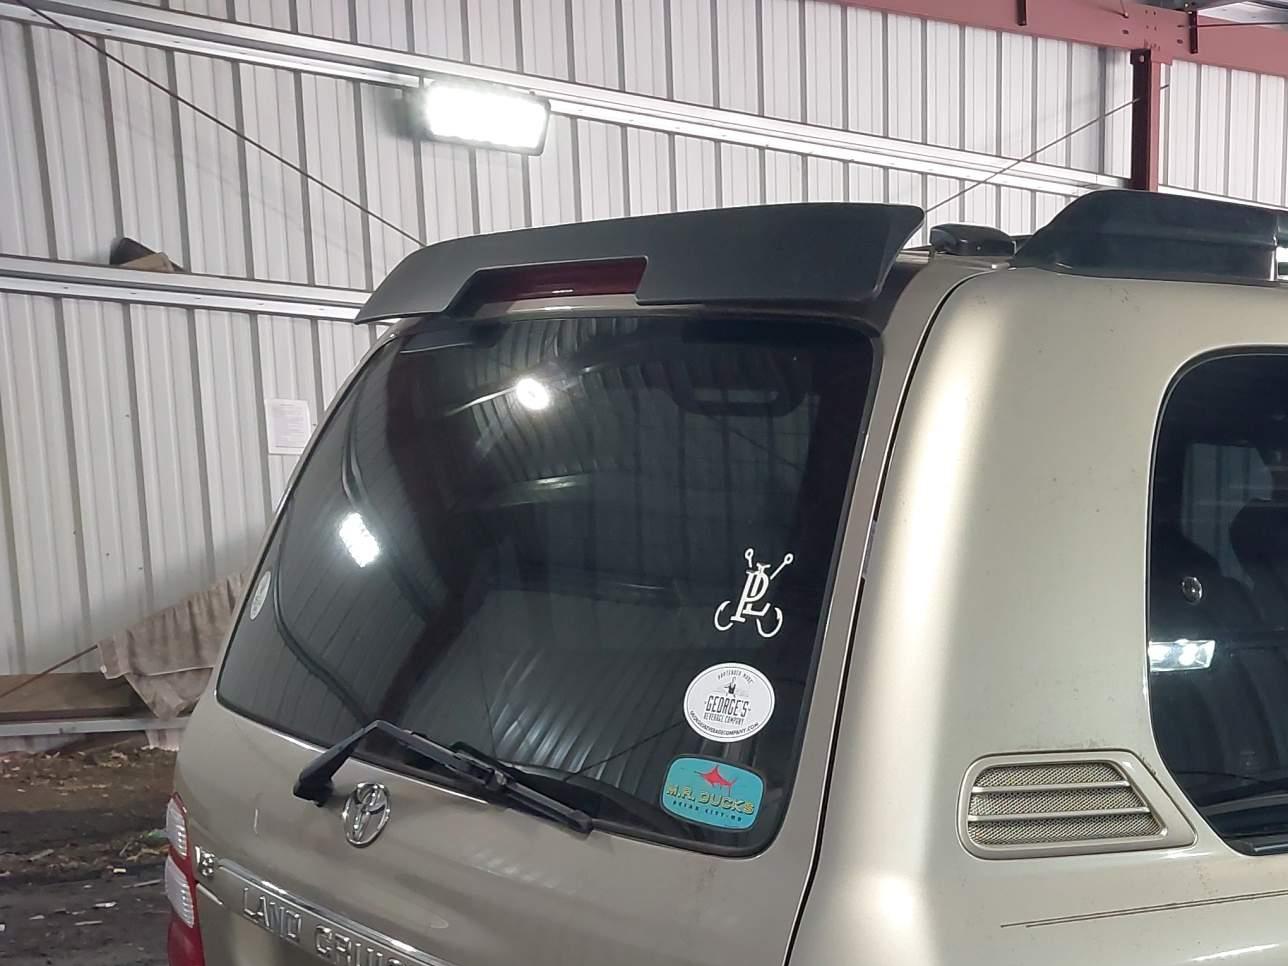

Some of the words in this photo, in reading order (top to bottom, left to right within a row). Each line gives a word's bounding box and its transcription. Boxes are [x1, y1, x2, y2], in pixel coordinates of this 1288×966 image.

[705, 695, 749, 718] GEORGE'S
[724, 715, 745, 726] COMPANY
[698, 791, 755, 815] DUCKS
[242, 886, 301, 940] LAND
